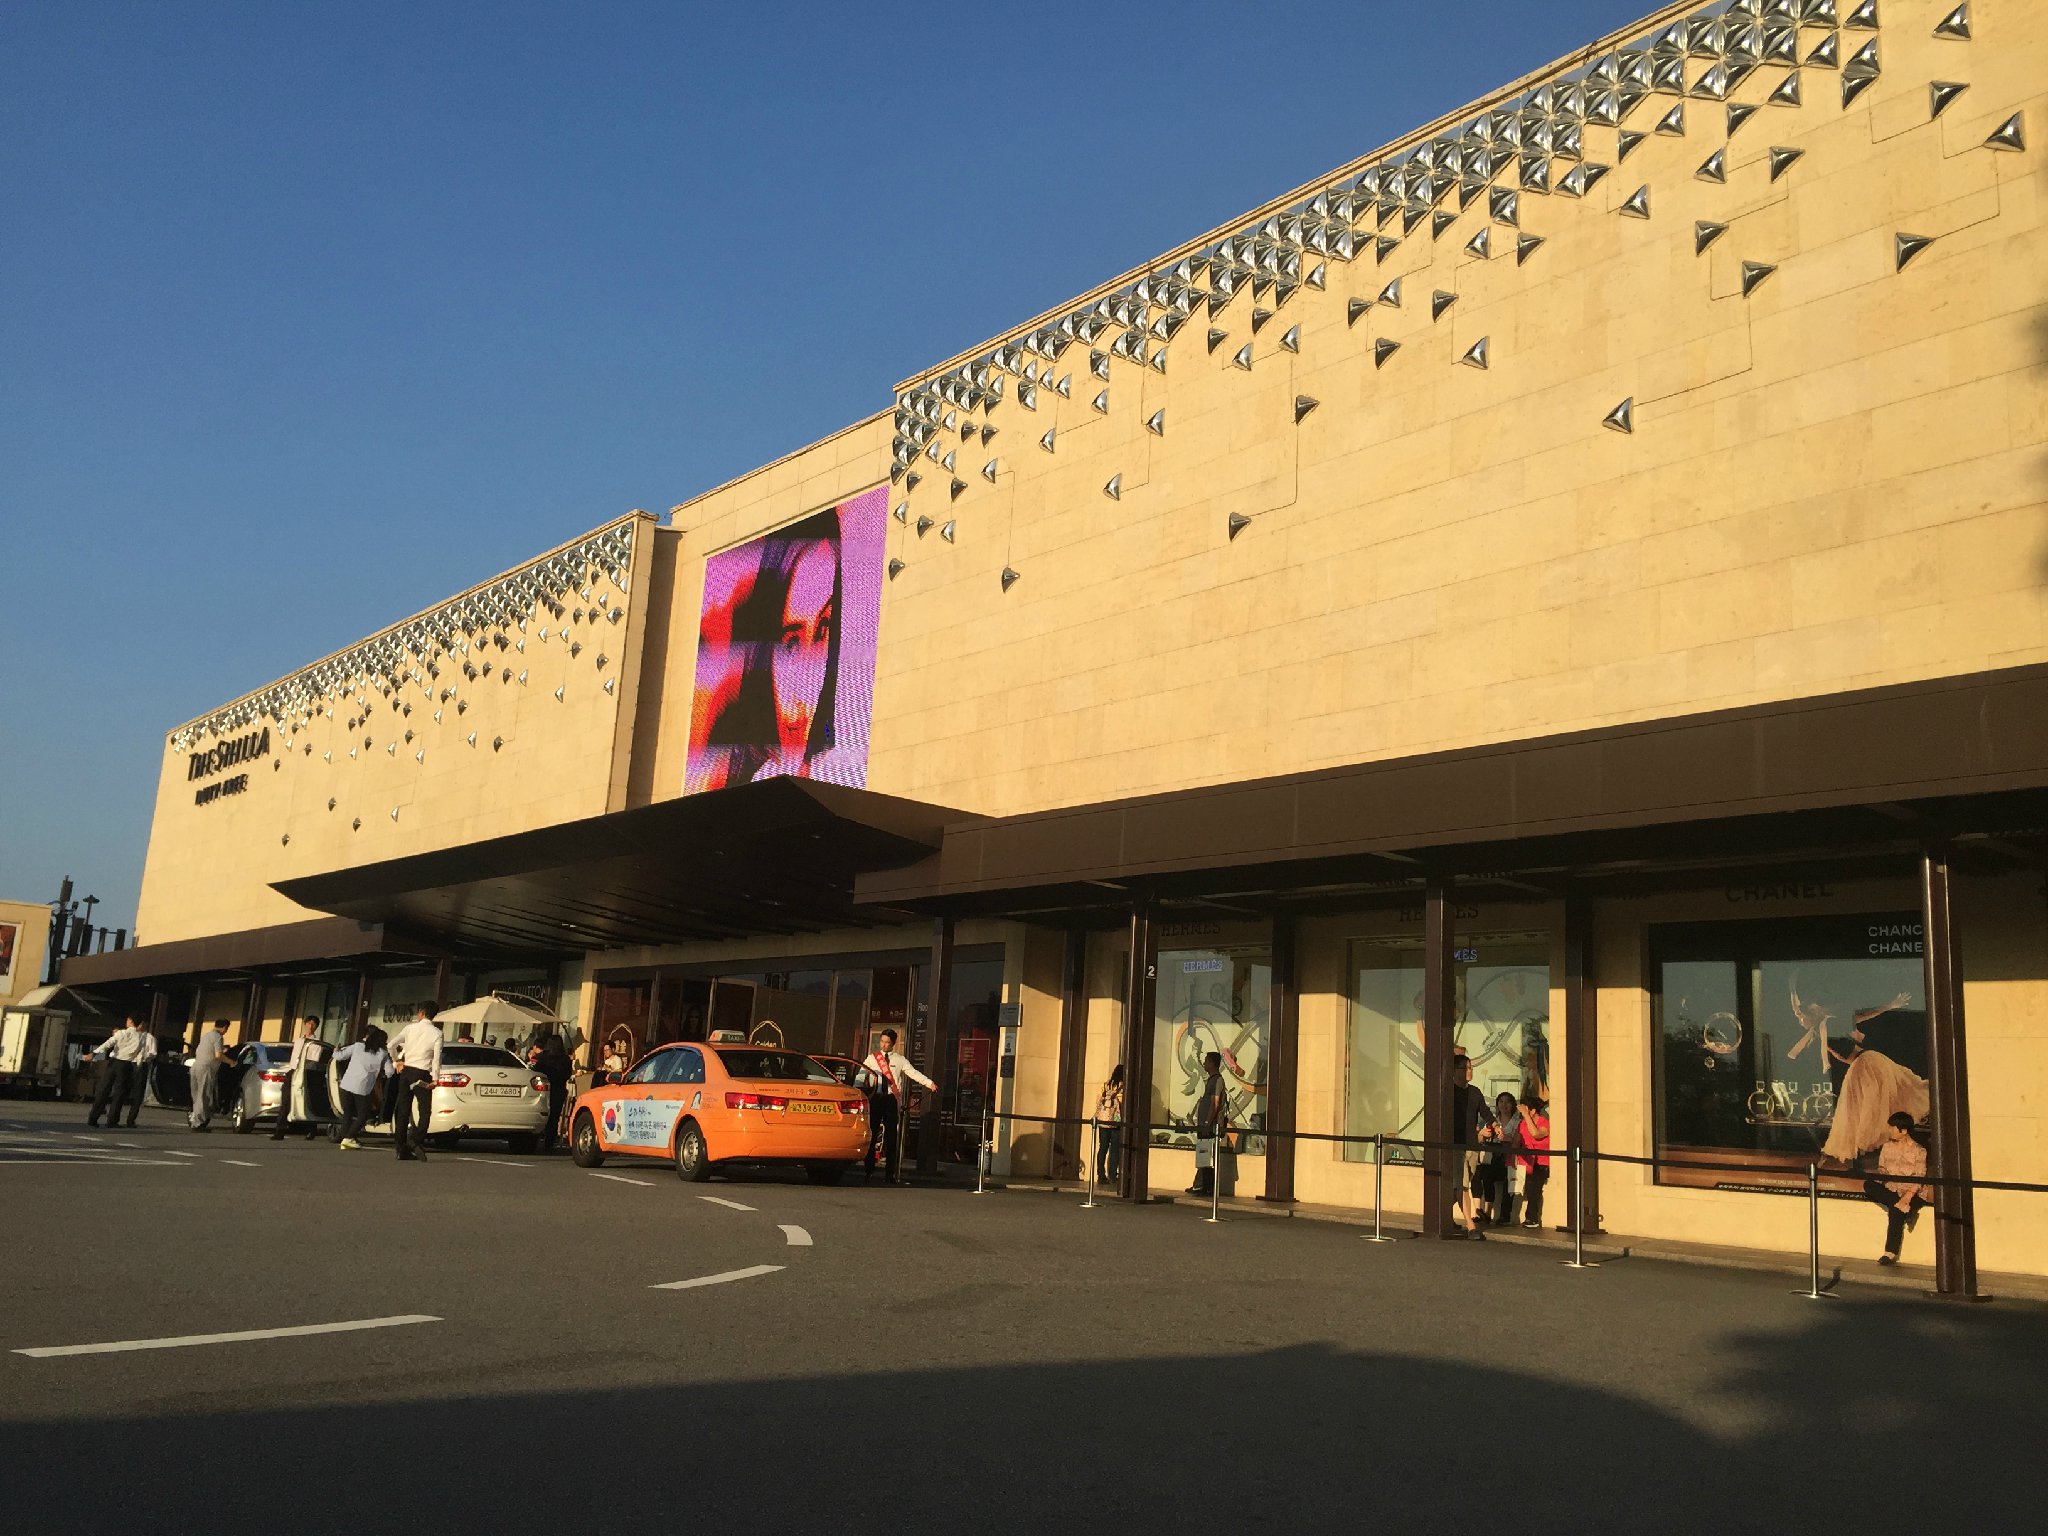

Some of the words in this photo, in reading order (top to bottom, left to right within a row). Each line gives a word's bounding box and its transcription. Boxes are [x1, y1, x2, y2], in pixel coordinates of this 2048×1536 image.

[214, 727, 269, 772] SHILLA
[1725, 884, 1834, 902] CHANEL
[1868, 924, 1923, 937] CHANC
[1868, 941, 1924, 954] CHANE
[1148, 965, 1155, 977] 2
[383, 1003, 415, 1023] LOUIS
